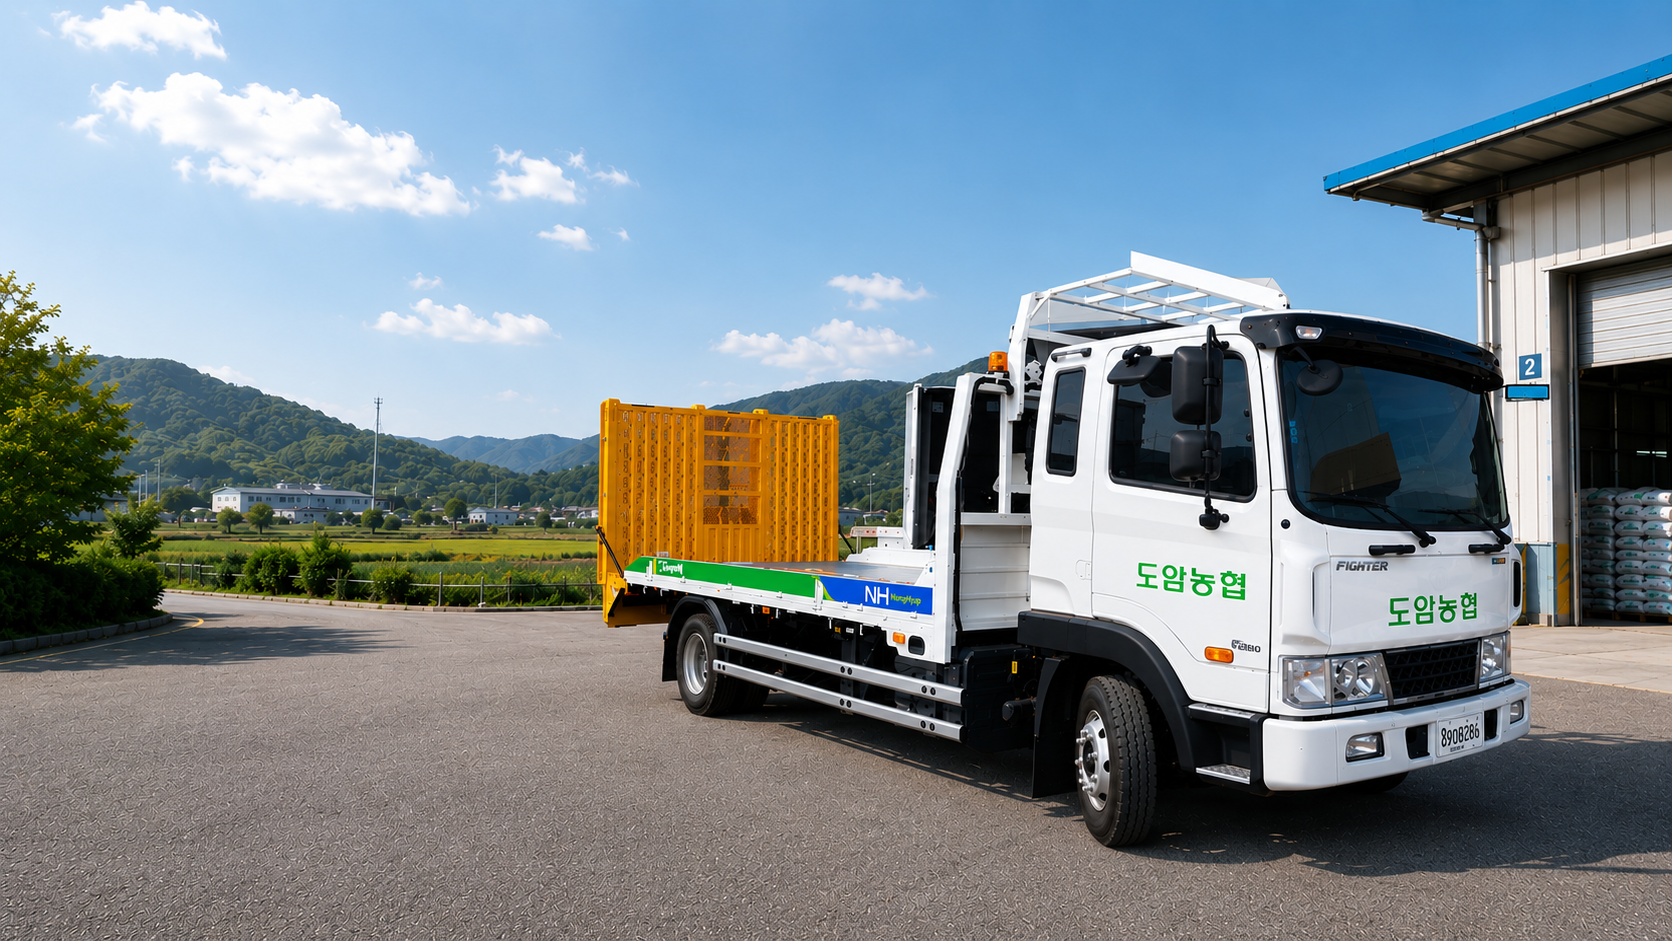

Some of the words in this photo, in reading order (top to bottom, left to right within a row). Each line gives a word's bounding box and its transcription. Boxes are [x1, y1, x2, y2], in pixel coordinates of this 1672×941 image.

[1525, 358, 1535, 376] 2
[1336, 560, 1389, 571] FIGHTER
[1136, 562, 1246, 600] 도암농협
[865, 585, 889, 606] NH
[1388, 592, 1477, 626] 도암농협
